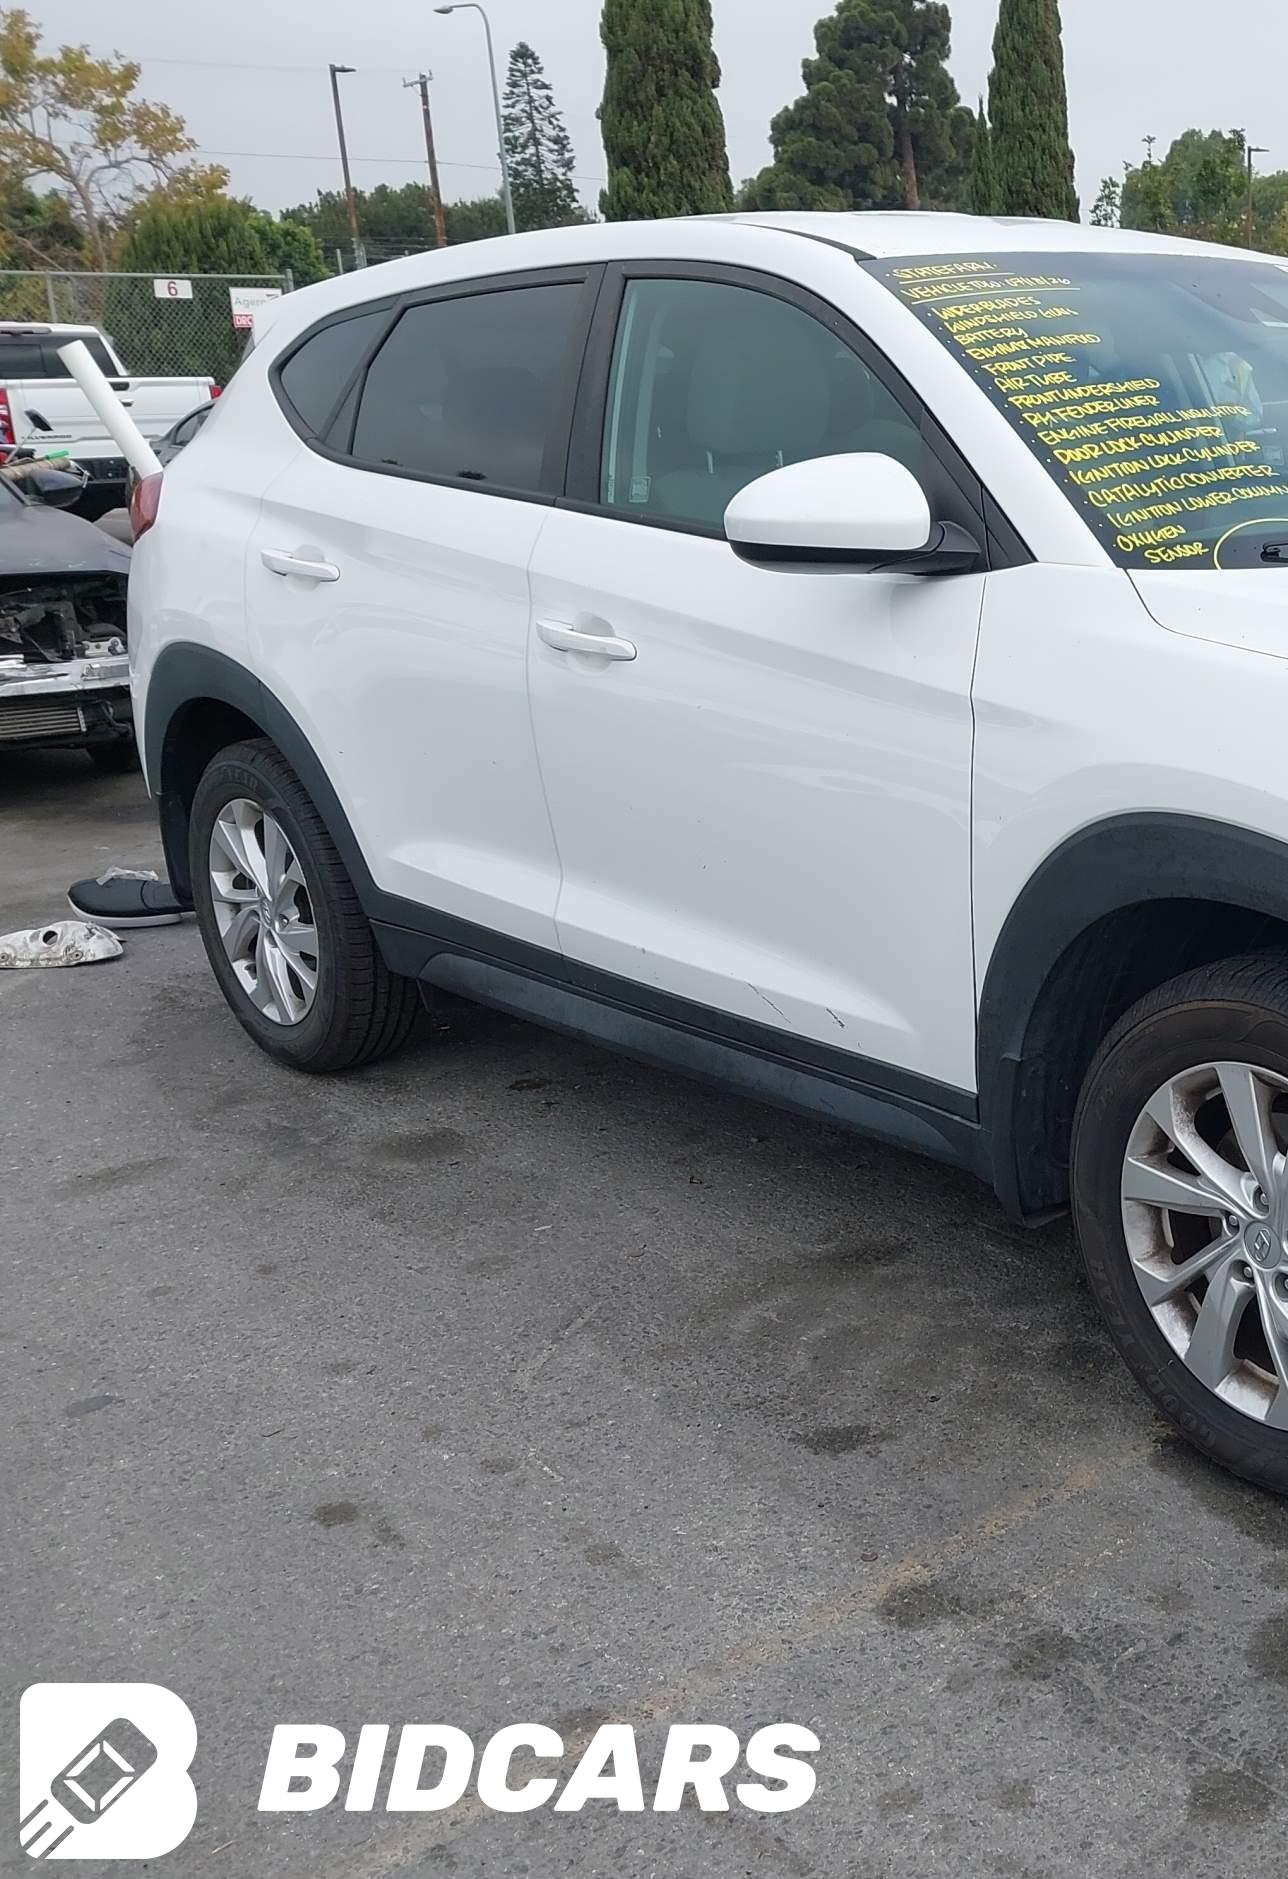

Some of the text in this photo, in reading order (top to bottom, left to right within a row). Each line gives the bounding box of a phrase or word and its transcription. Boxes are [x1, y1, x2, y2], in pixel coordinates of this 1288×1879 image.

[167, 281, 178, 296] 6
[943, 310, 1037, 333] WINDSHIELD
[953, 327, 1029, 346] BATTERY
[1027, 333, 1101, 351] MANIFOLD
[981, 358, 1035, 376] FRONT
[1038, 404, 1253, 446] ENGINE FIREWALL INSULATOR
[1053, 426, 1224, 465] DOOR LOCK CYLINDER
[1069, 439, 1260, 486] IGNITION LOCK CYLINDER
[1107, 502, 1183, 529] IGNITION
[1181, 491, 1236, 511] LOWER
[1117, 524, 1186, 552] OXYGEN
[1145, 541, 1209, 564] SENSOR
